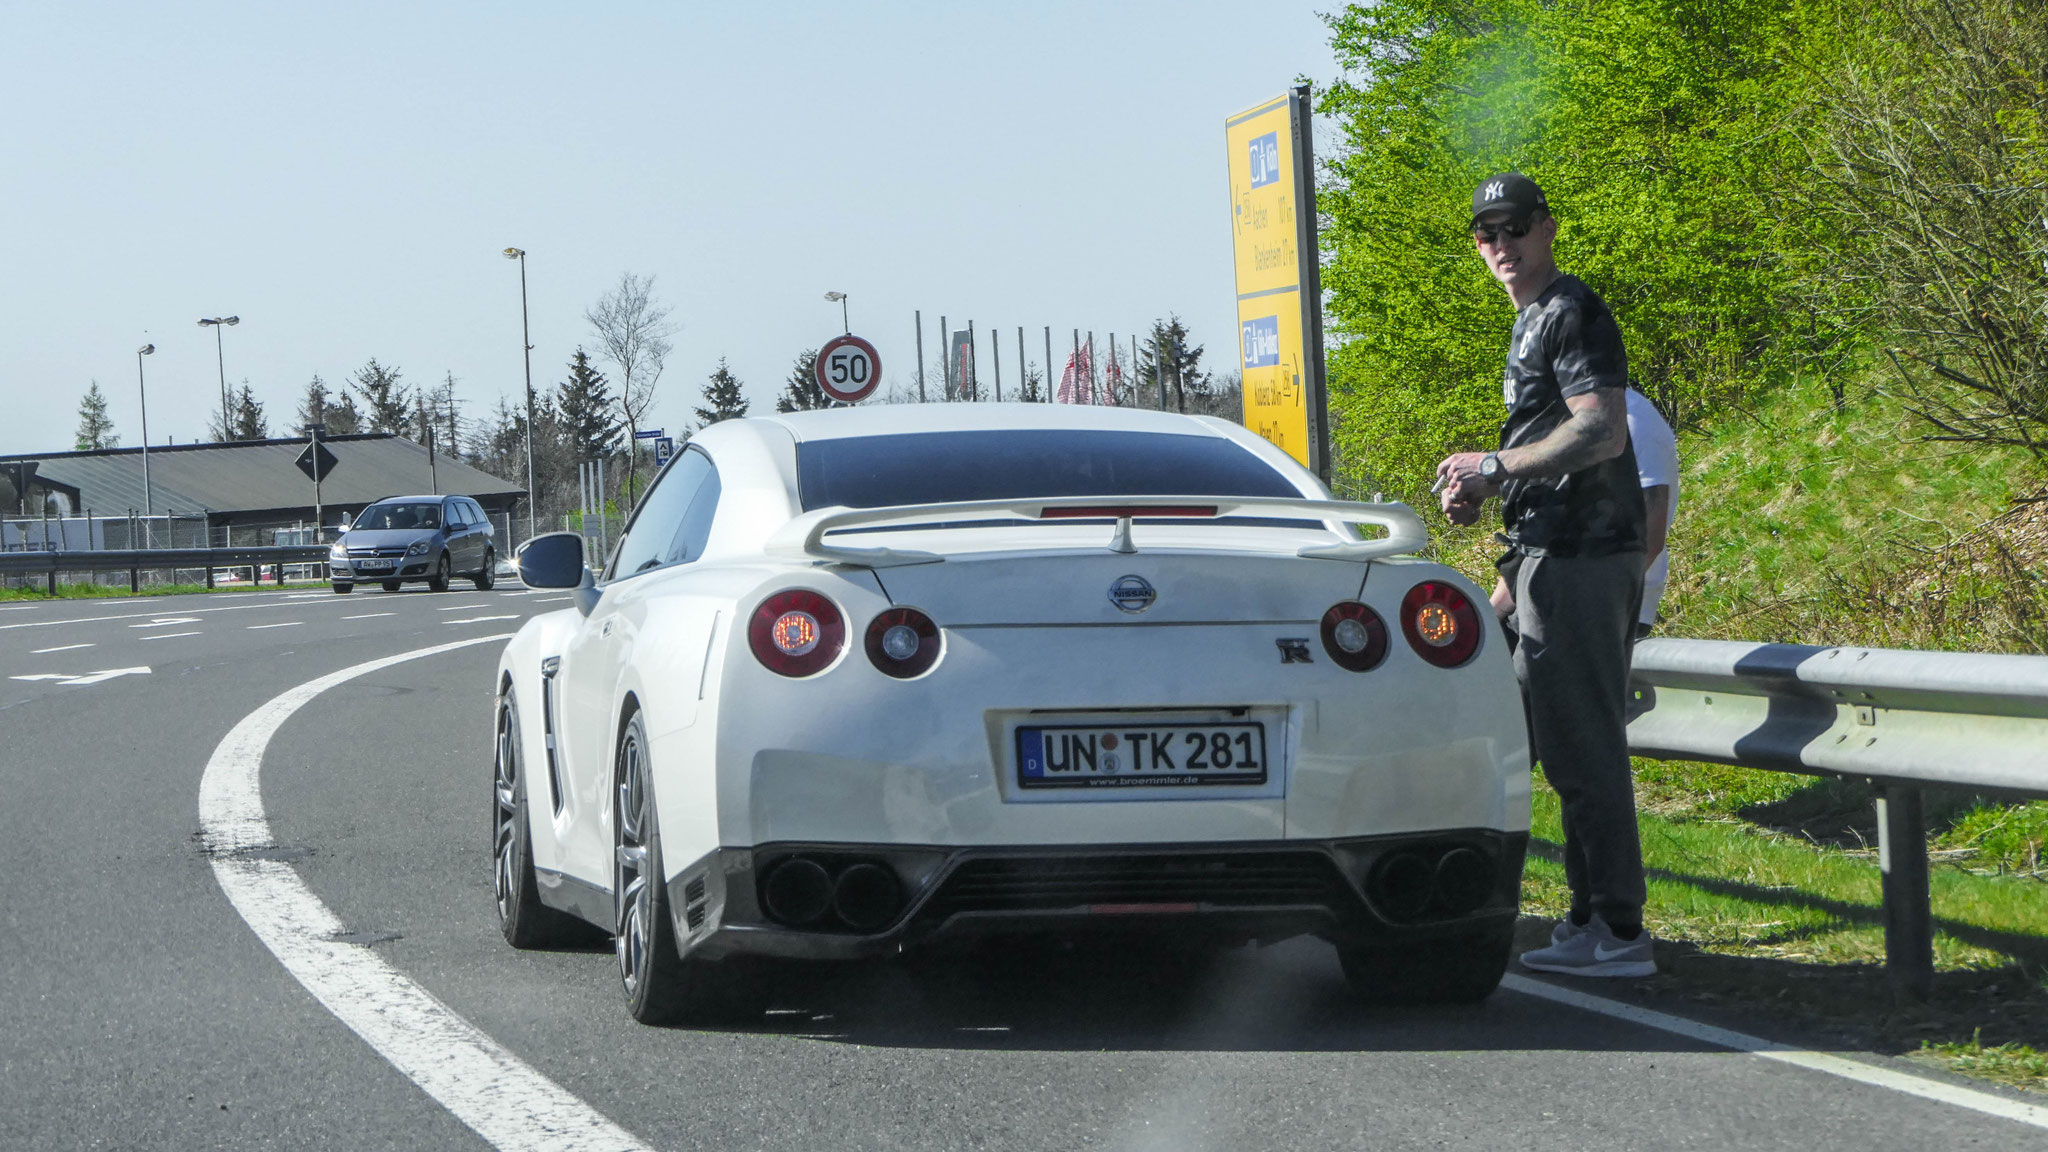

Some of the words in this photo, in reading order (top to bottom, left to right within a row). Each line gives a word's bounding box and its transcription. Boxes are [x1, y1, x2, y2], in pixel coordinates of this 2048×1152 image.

[1484, 180, 1504, 202] NY
[1253, 203, 1268, 230] Aachen
[832, 354, 867, 384] 50
[1254, 379, 1271, 406] Koblenz
[1113, 589, 1152, 598] NISSAN
[1028, 759, 1037, 770] D
[1045, 734, 1098, 771] UN
[1124, 732, 1176, 770] TK
[1185, 731, 1258, 769] 281
